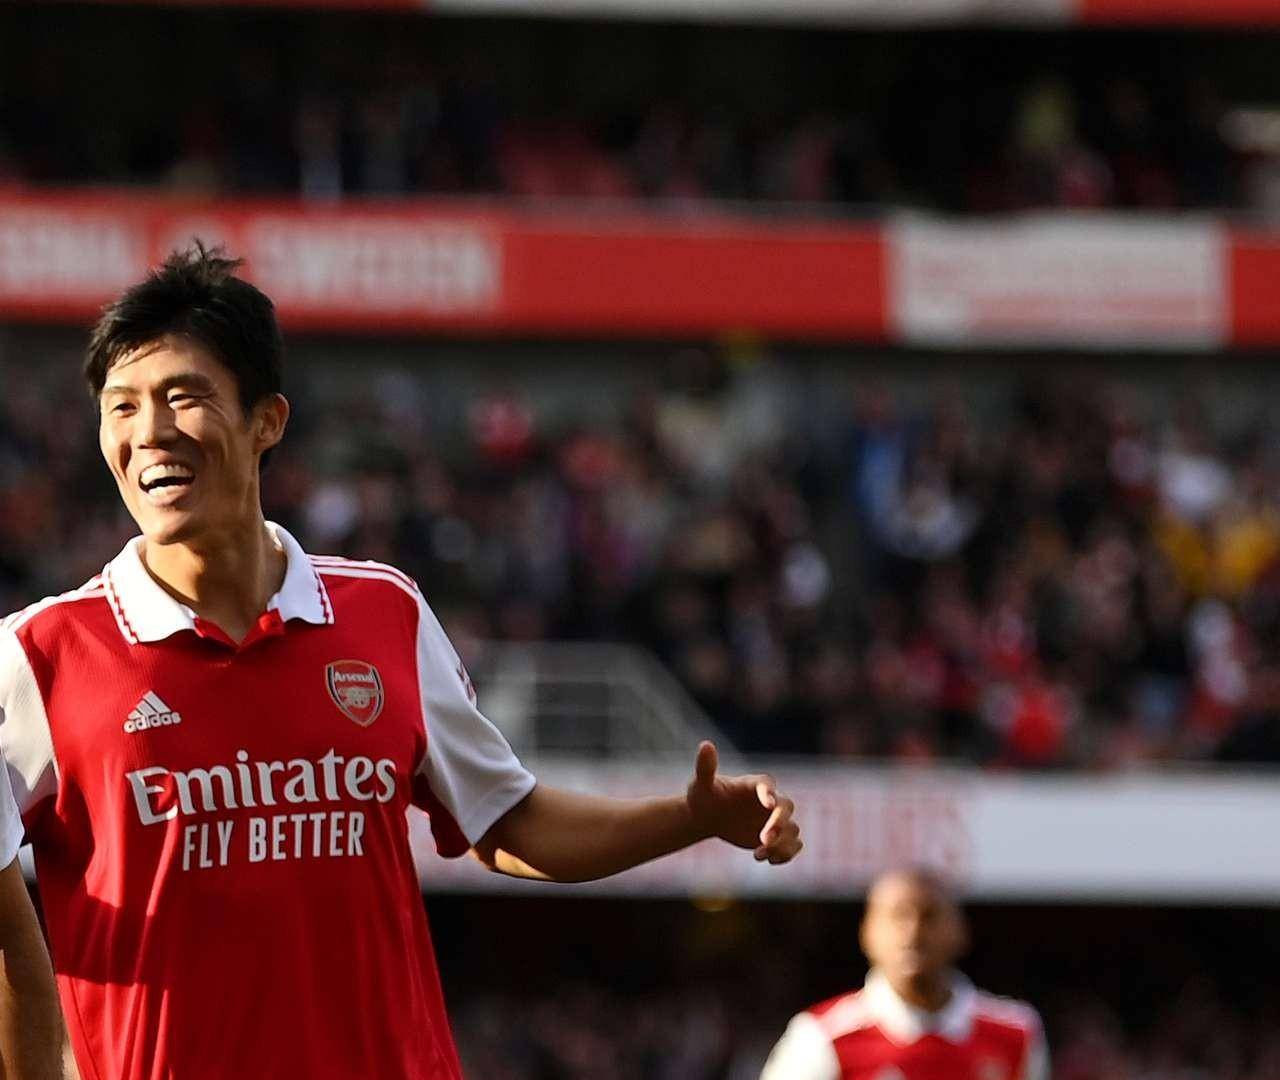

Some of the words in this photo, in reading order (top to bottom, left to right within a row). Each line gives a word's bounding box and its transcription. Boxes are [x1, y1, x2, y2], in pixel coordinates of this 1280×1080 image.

[124, 711, 182, 733] adidas
[125, 747, 397, 826] Emirates
[182, 820, 234, 871] FLY
[249, 811, 365, 862] BETTER
